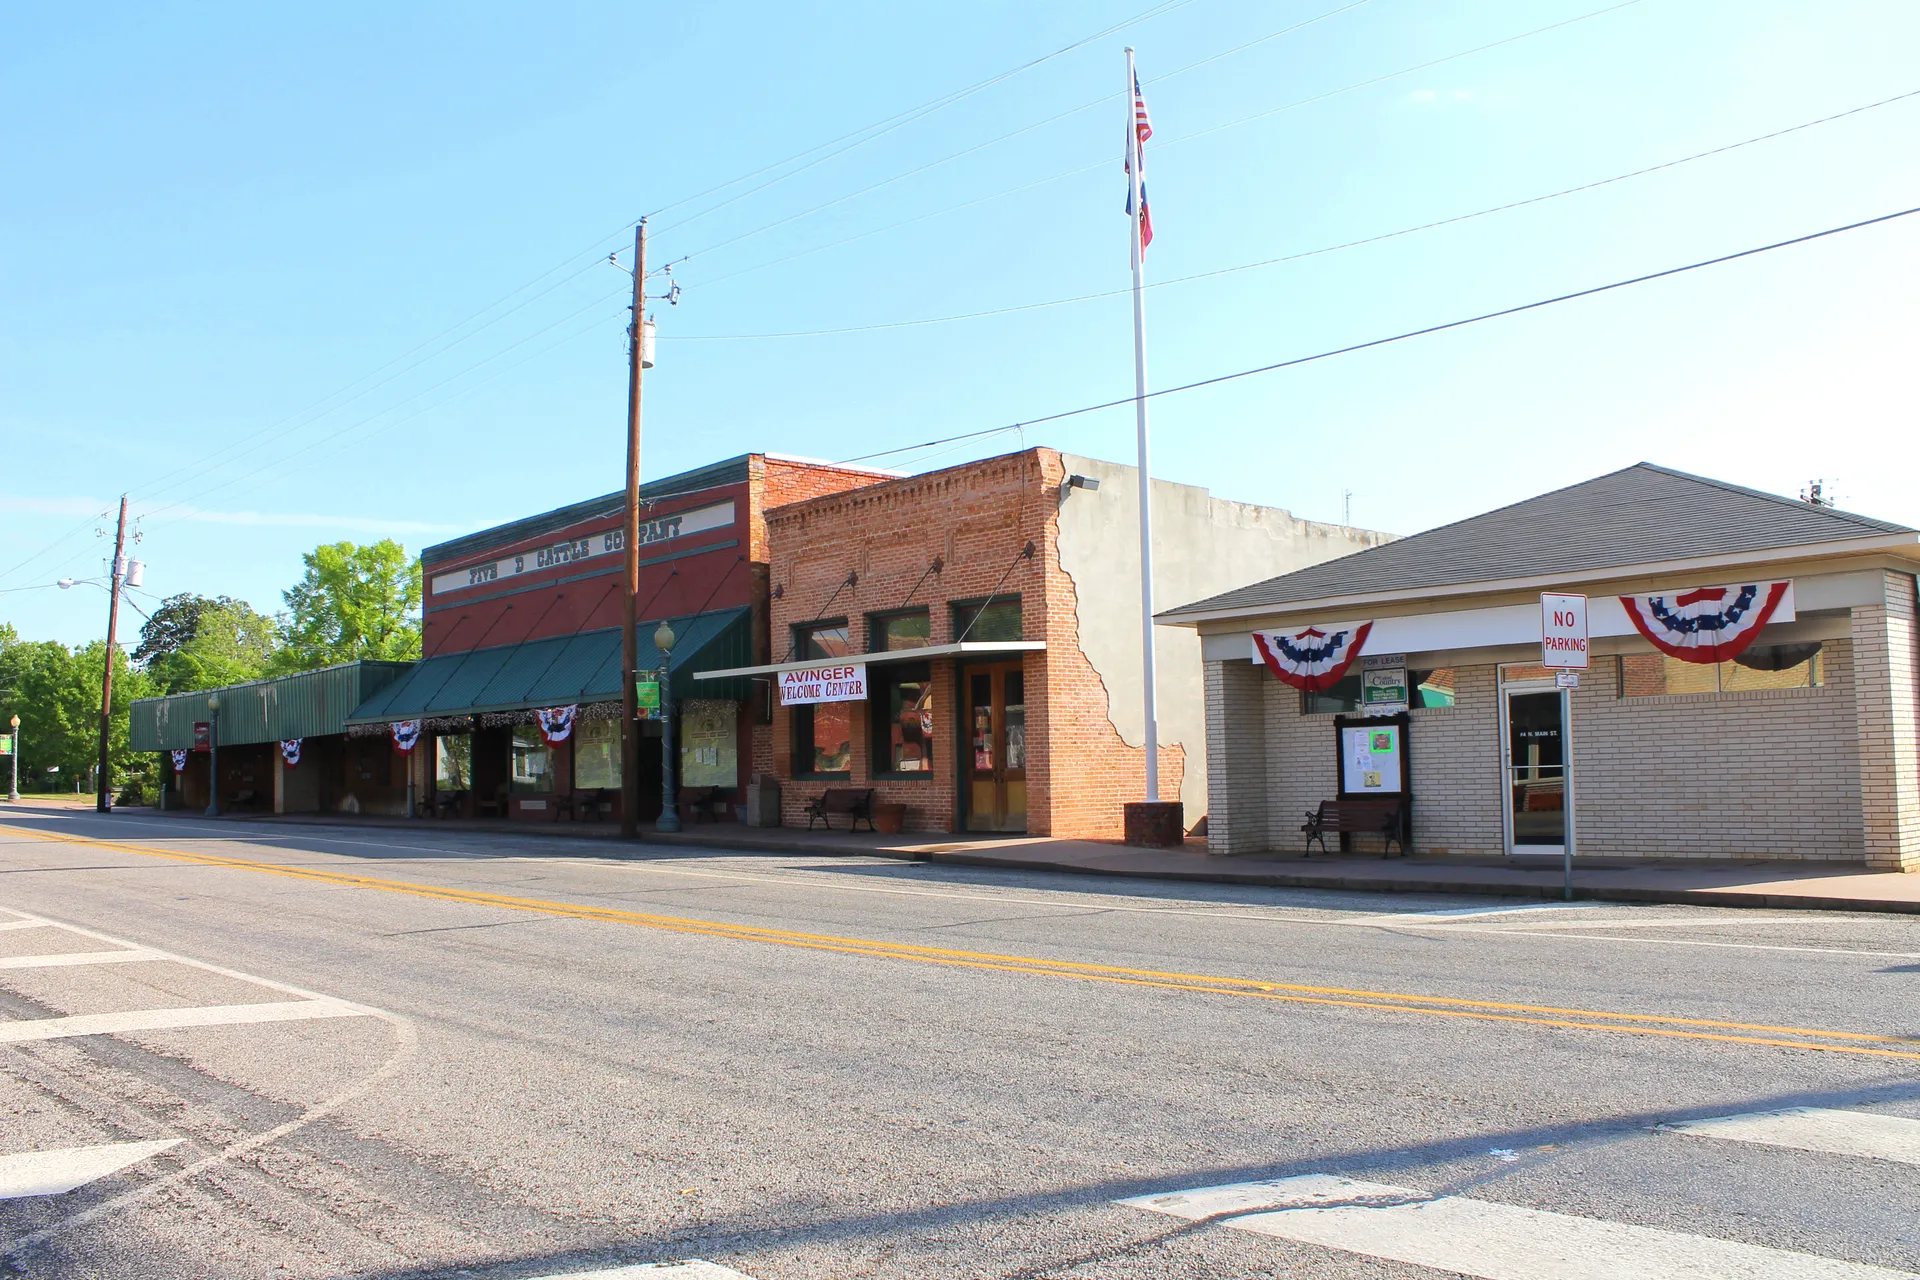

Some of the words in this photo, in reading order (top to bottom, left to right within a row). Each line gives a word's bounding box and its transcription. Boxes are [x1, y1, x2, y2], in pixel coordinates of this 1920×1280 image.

[469, 563, 498, 584] FIVE
[515, 556, 524, 573] D
[537, 540, 590, 567] CATTLE
[604, 516, 683, 552] COPANY
[1554, 611, 1575, 627] NO
[1545, 637, 1586, 651] PARKING
[1363, 658, 1378, 666] FOR
[1381, 656, 1405, 665] LEASE
[785, 666, 855, 684] AVINGER
[1372, 676, 1401, 686] Country
[780, 683, 822, 700] WELCOME
[825, 680, 864, 697] CENTER
